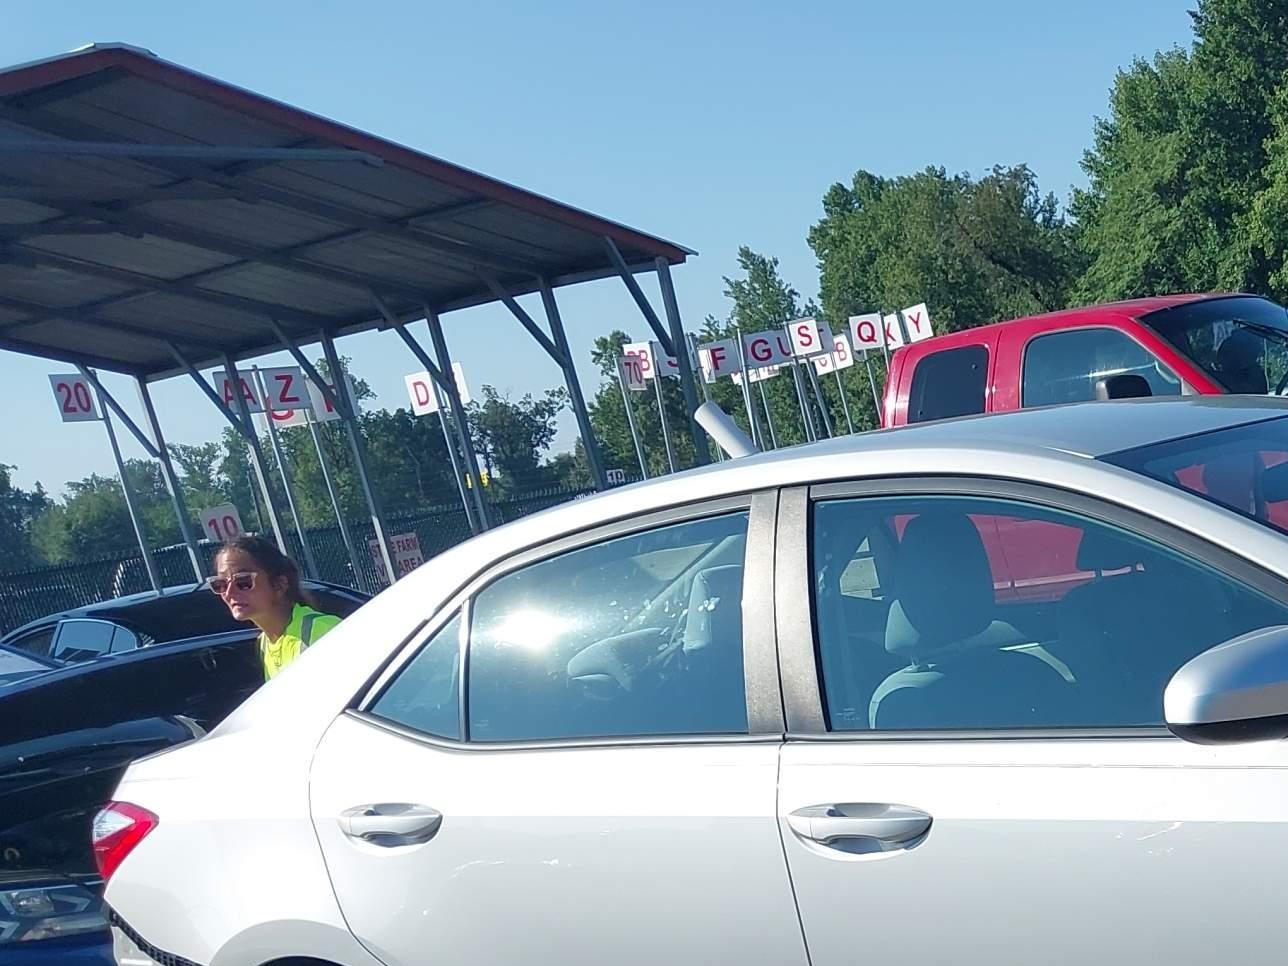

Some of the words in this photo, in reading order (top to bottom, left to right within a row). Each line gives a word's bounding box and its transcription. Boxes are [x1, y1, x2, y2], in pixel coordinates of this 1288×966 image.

[857, 321, 877, 342] Q
[909, 312, 920, 333] Y
[797, 325, 812, 347] S
[710, 347, 725, 370] F
[751, 339, 773, 361] G
[624, 362, 643, 384] 70
[57, 382, 91, 413] 20
[275, 374, 299, 403] Z
[413, 381, 429, 406] D
[208, 515, 240, 541] 10
[397, 537, 418, 553] FARM
